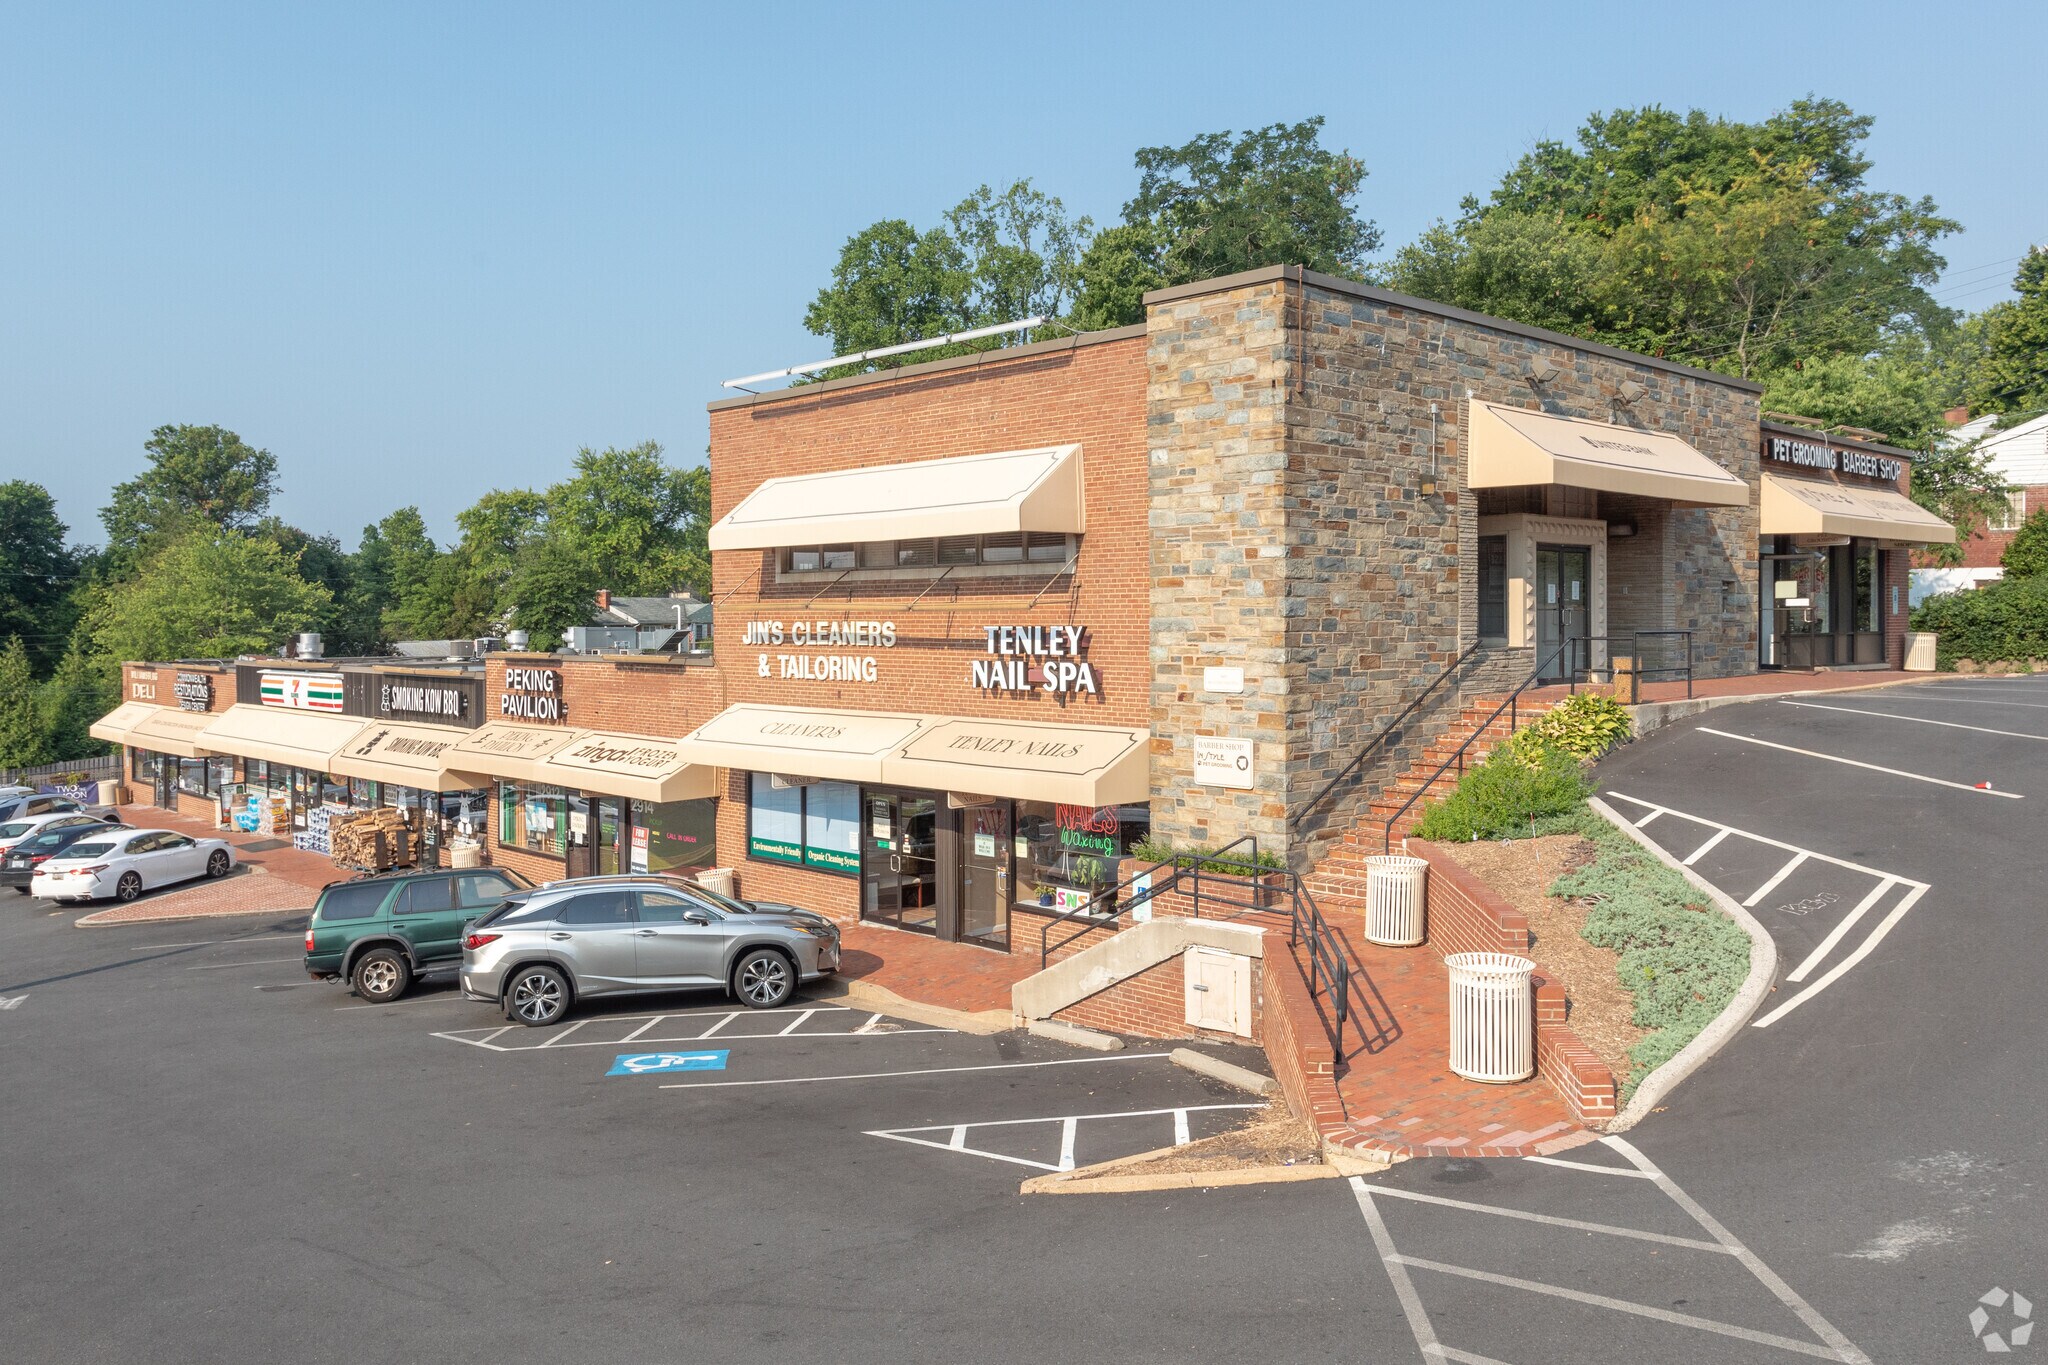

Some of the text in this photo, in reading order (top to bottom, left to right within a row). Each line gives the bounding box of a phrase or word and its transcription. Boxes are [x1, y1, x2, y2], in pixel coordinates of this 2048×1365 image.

[1773, 438, 1837, 469] PET GROOMING
[1843, 451, 1902, 481] BARBER SHOP
[742, 620, 897, 647] JIN'S CLEANERS
[983, 625, 1085, 656] TENLEY
[758, 653, 878, 682] & TAILORING
[972, 660, 1097, 693] NAIL SPA
[506, 669, 554, 692] PEKING
[132, 683, 156, 699] DELI
[174, 683, 208, 699] RESTORATIONS
[391, 686, 459, 717] SMOKING KOW BBQ
[501, 694, 558, 719] PAVILION
[760, 722, 847, 739] CLEANERS
[634, 748, 678, 760] FROZEN
[948, 735, 1084, 758] TENLEY NAILS
[623, 756, 671, 768] YOGURT
[63, 791, 88, 799] OON
[631, 799, 654, 814] 2914
[635, 828, 645, 838] FOR
[666, 832, 677, 840] CALL
[1061, 826, 1113, 857] Waxing
[633, 837, 647, 848] LEASE
[753, 841, 802, 859] Environmentally Friendly
[807, 850, 825, 862] Organic
[825, 851, 844, 866] Cleaning
[1057, 891, 1088, 909] SNS
